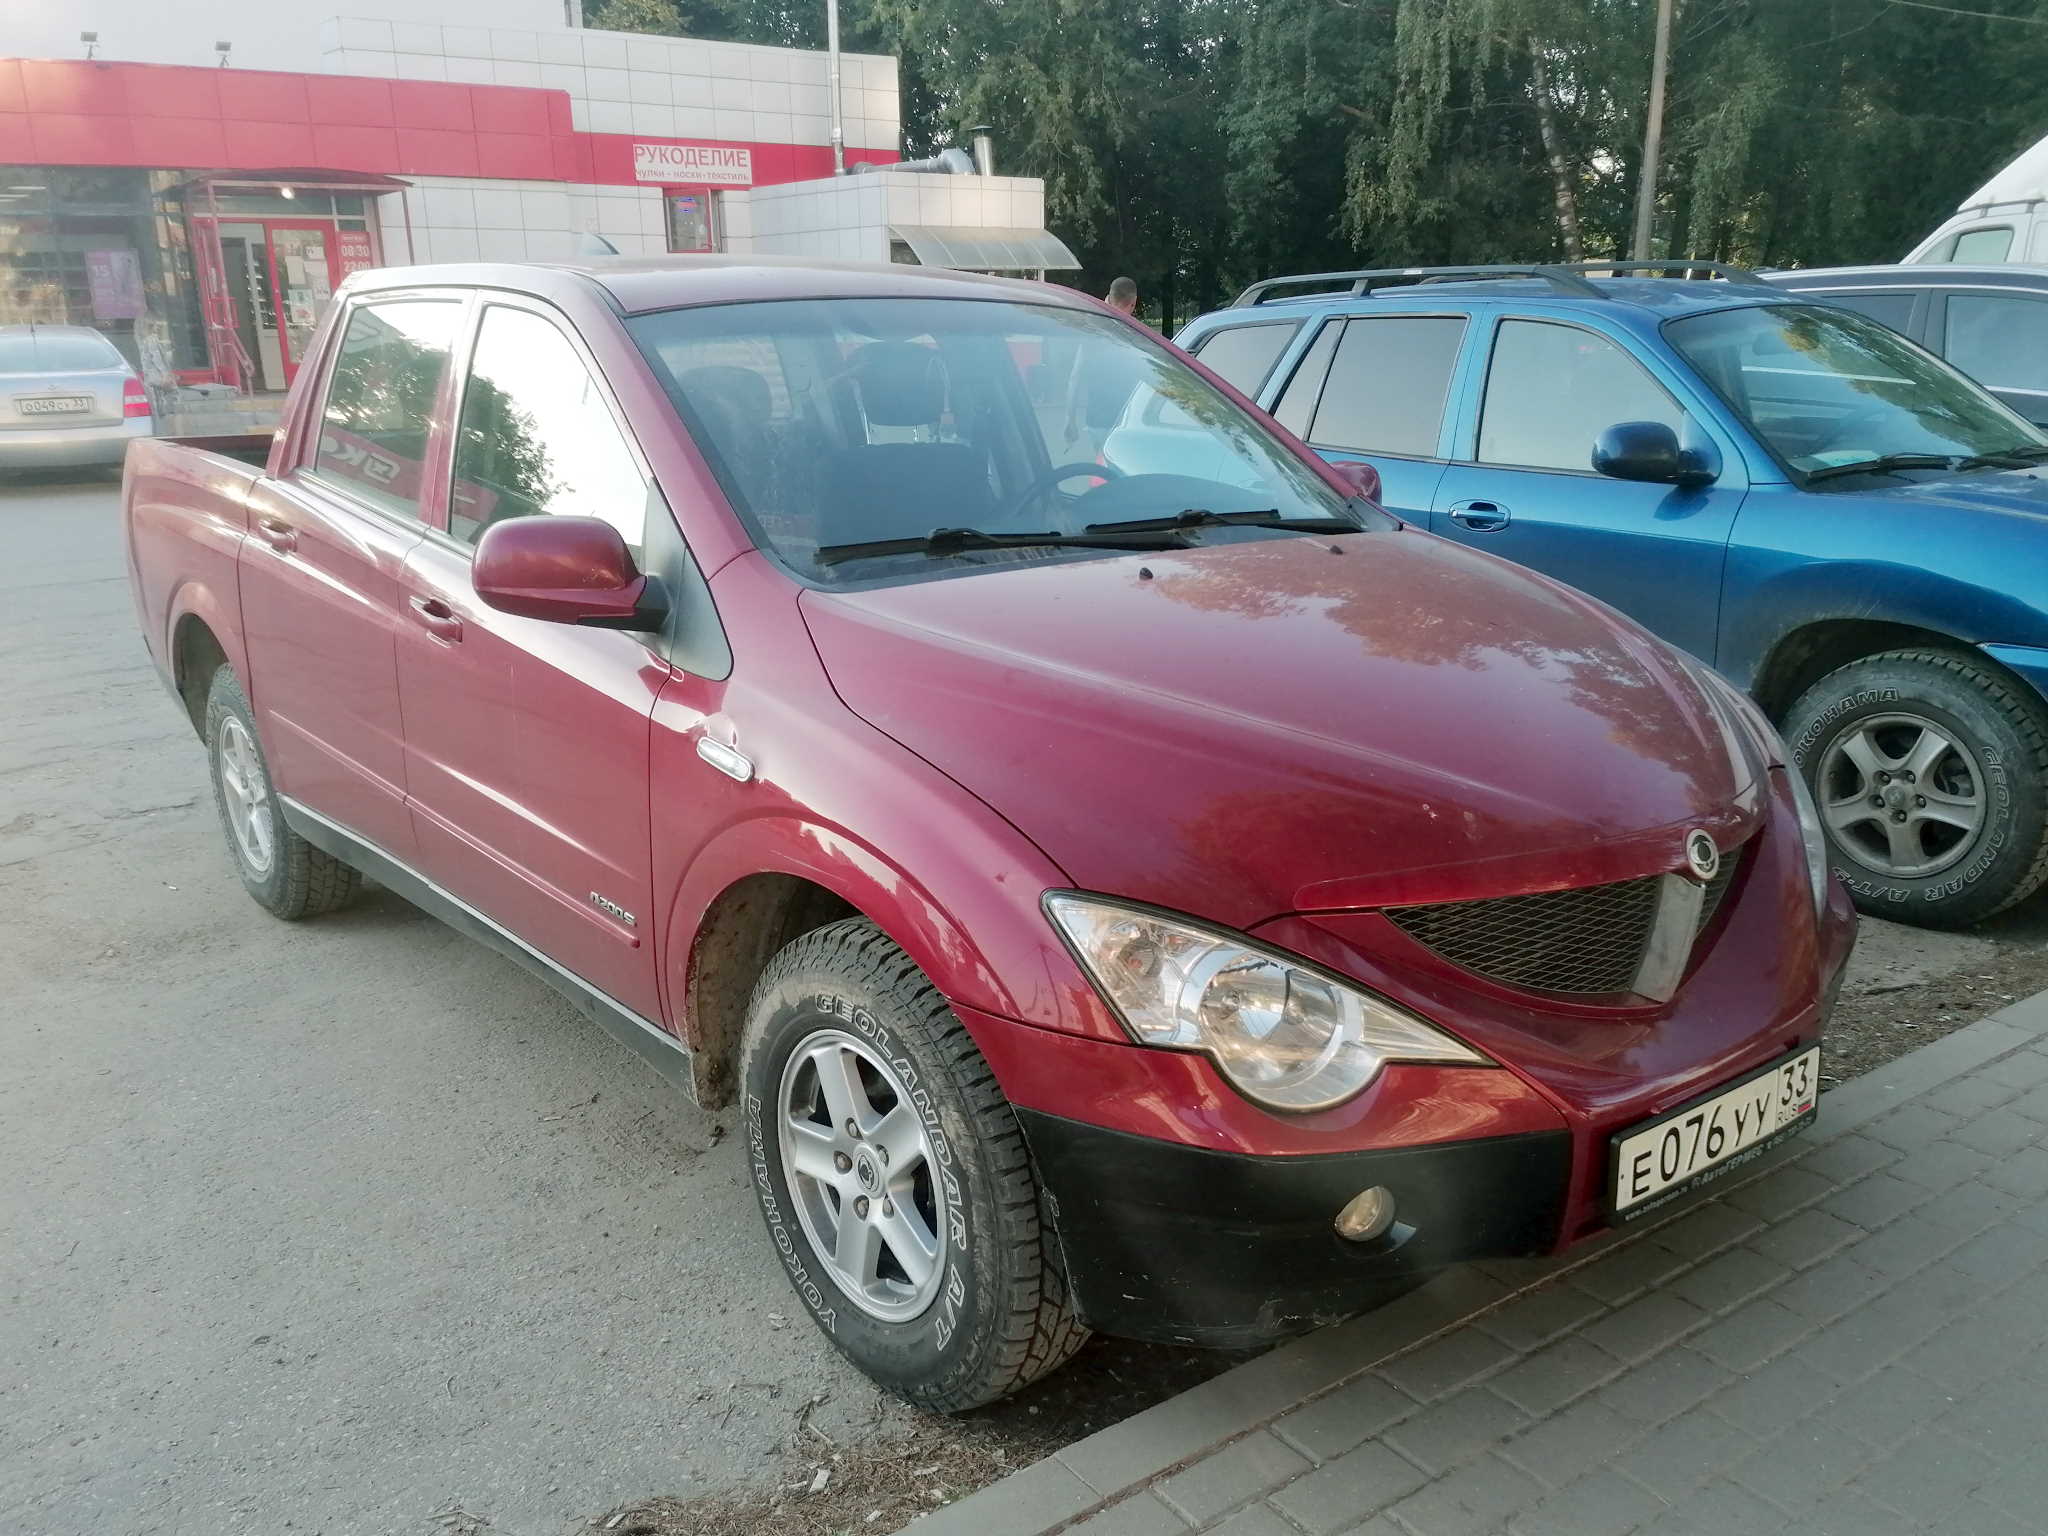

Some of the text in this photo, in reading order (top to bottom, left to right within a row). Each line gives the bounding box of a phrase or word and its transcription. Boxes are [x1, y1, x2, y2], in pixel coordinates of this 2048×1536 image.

[634, 146, 748, 168] РУКОДЕЛИЕ
[1793, 687, 1898, 769] OKOHAMA
[1924, 746, 2010, 902] GEOLANDAR
[1781, 1057, 1809, 1106] 33
[747, 1094, 839, 1335] YOKOHAMA
[815, 992, 968, 1352] GEOLANDAR A/T
